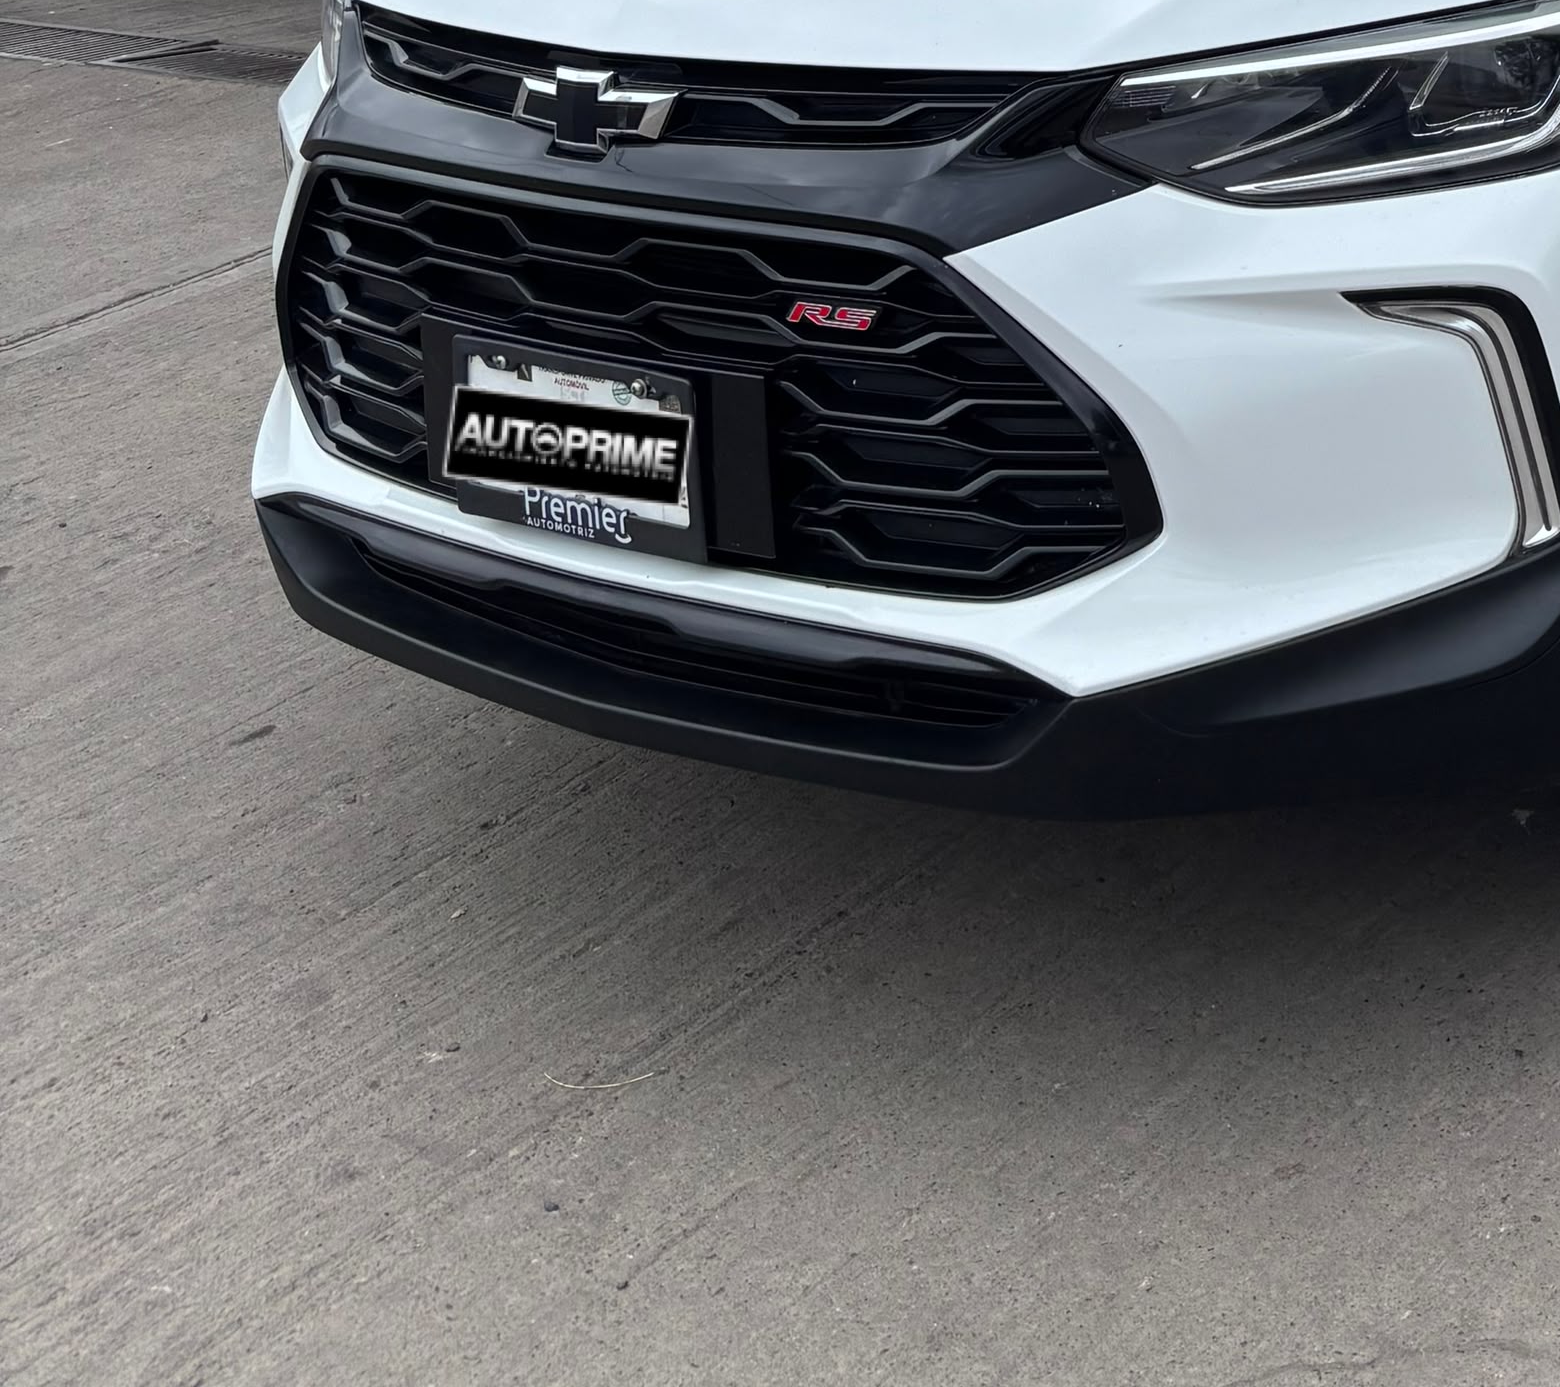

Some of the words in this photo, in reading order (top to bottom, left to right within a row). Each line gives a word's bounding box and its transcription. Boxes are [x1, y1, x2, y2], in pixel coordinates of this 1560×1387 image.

[786, 301, 877, 331] RS
[524, 485, 632, 543] Premier
[526, 516, 596, 539] AUTOMOTRIZ
